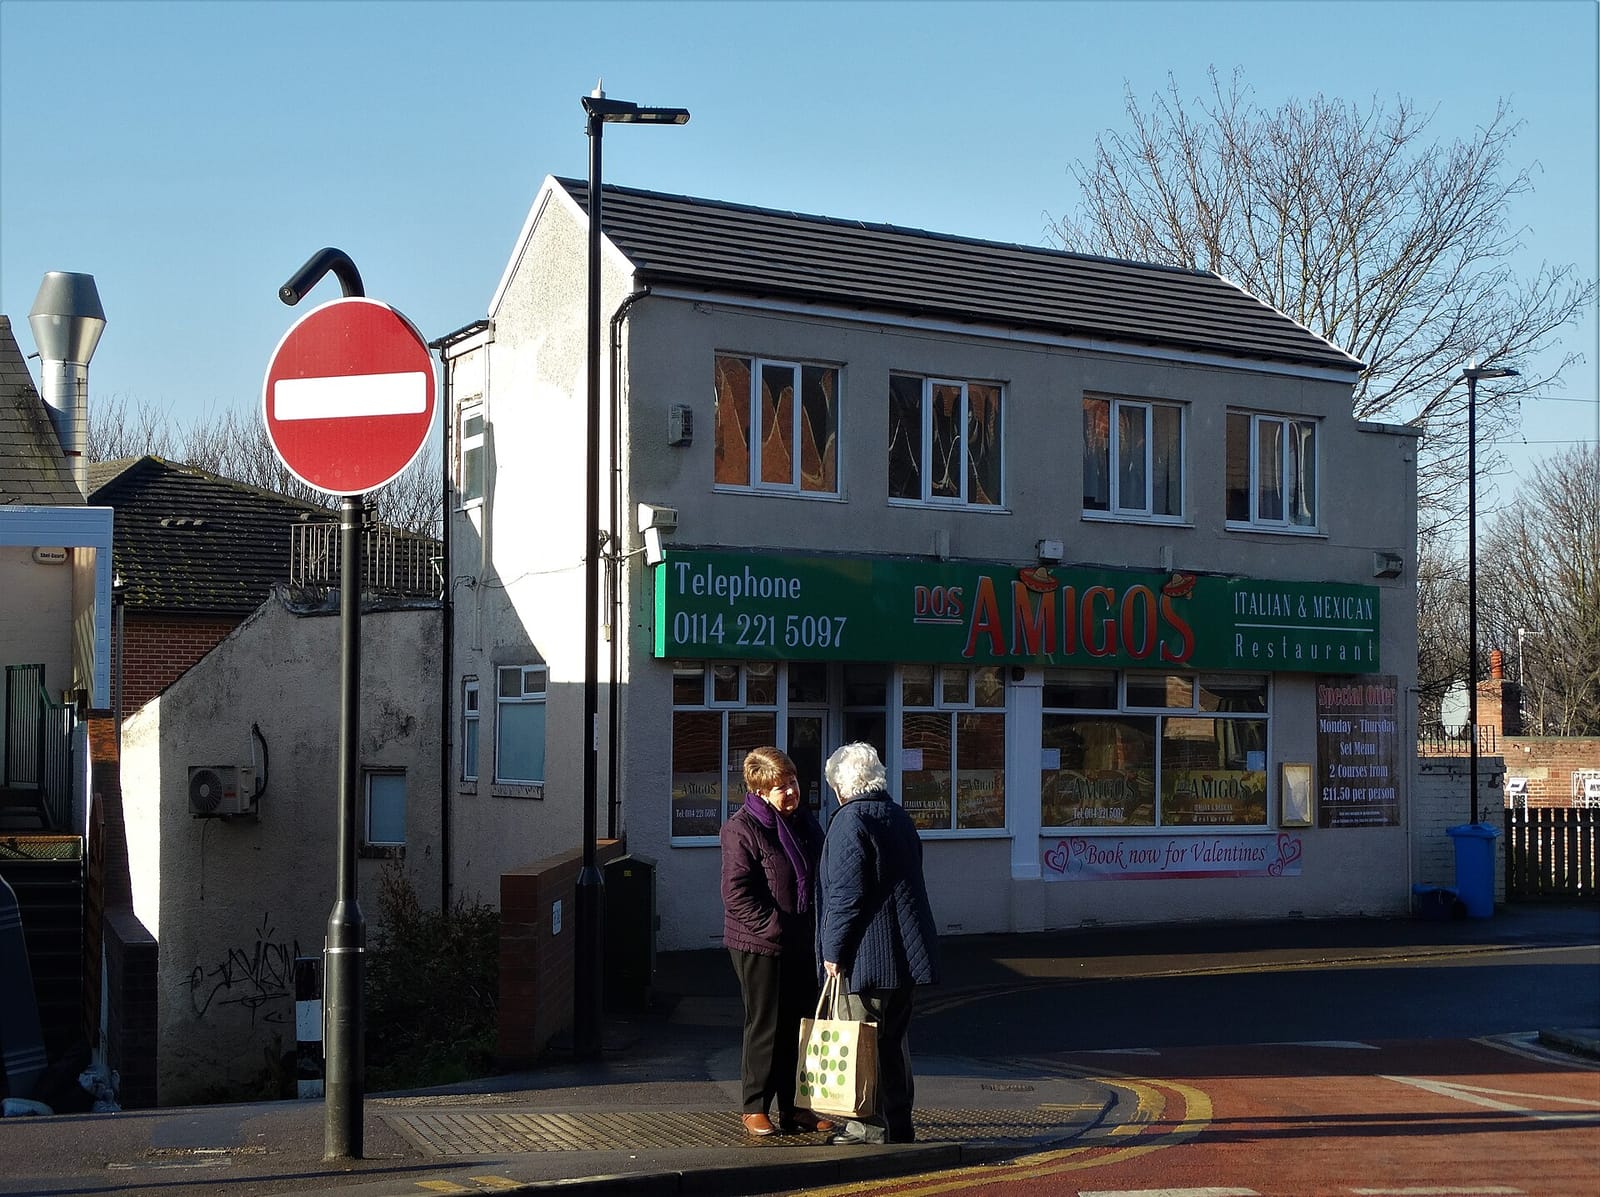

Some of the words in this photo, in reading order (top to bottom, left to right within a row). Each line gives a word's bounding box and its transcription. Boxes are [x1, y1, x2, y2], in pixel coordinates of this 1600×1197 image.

[674, 561, 801, 605] Telephone
[1234, 591, 1291, 617] ITALIAN
[1298, 595, 1307, 618] &
[1313, 595, 1373, 620] MEXICAN
[674, 611, 725, 644] 0114
[736, 613, 775, 645] 221
[785, 615, 848, 648] 5097
[914, 586, 964, 617] DOS
[962, 575, 1196, 664] AMIGOS
[1235, 633, 1374, 662] Restaurant
[1318, 684, 1363, 708] Special
[1366, 684, 1396, 706] Offer
[1319, 719, 1351, 734] Monday
[1359, 719, 1395, 735] Thursday
[1340, 742, 1352, 755] Set
[1354, 741, 1376, 755] Menu
[1329, 764, 1335, 778] 2
[1338, 764, 1368, 778] Courses
[1369, 764, 1388, 777] from
[1072, 777, 1137, 800] AMIGOS
[1191, 778, 1252, 800] AMIGOS
[1322, 787, 1350, 801] £11.50
[1352, 788, 1366, 802] per
[1368, 787, 1395, 801] person
[1086, 841, 1128, 869] Book
[1128, 850, 1161, 864] now
[1161, 840, 1188, 870] for
